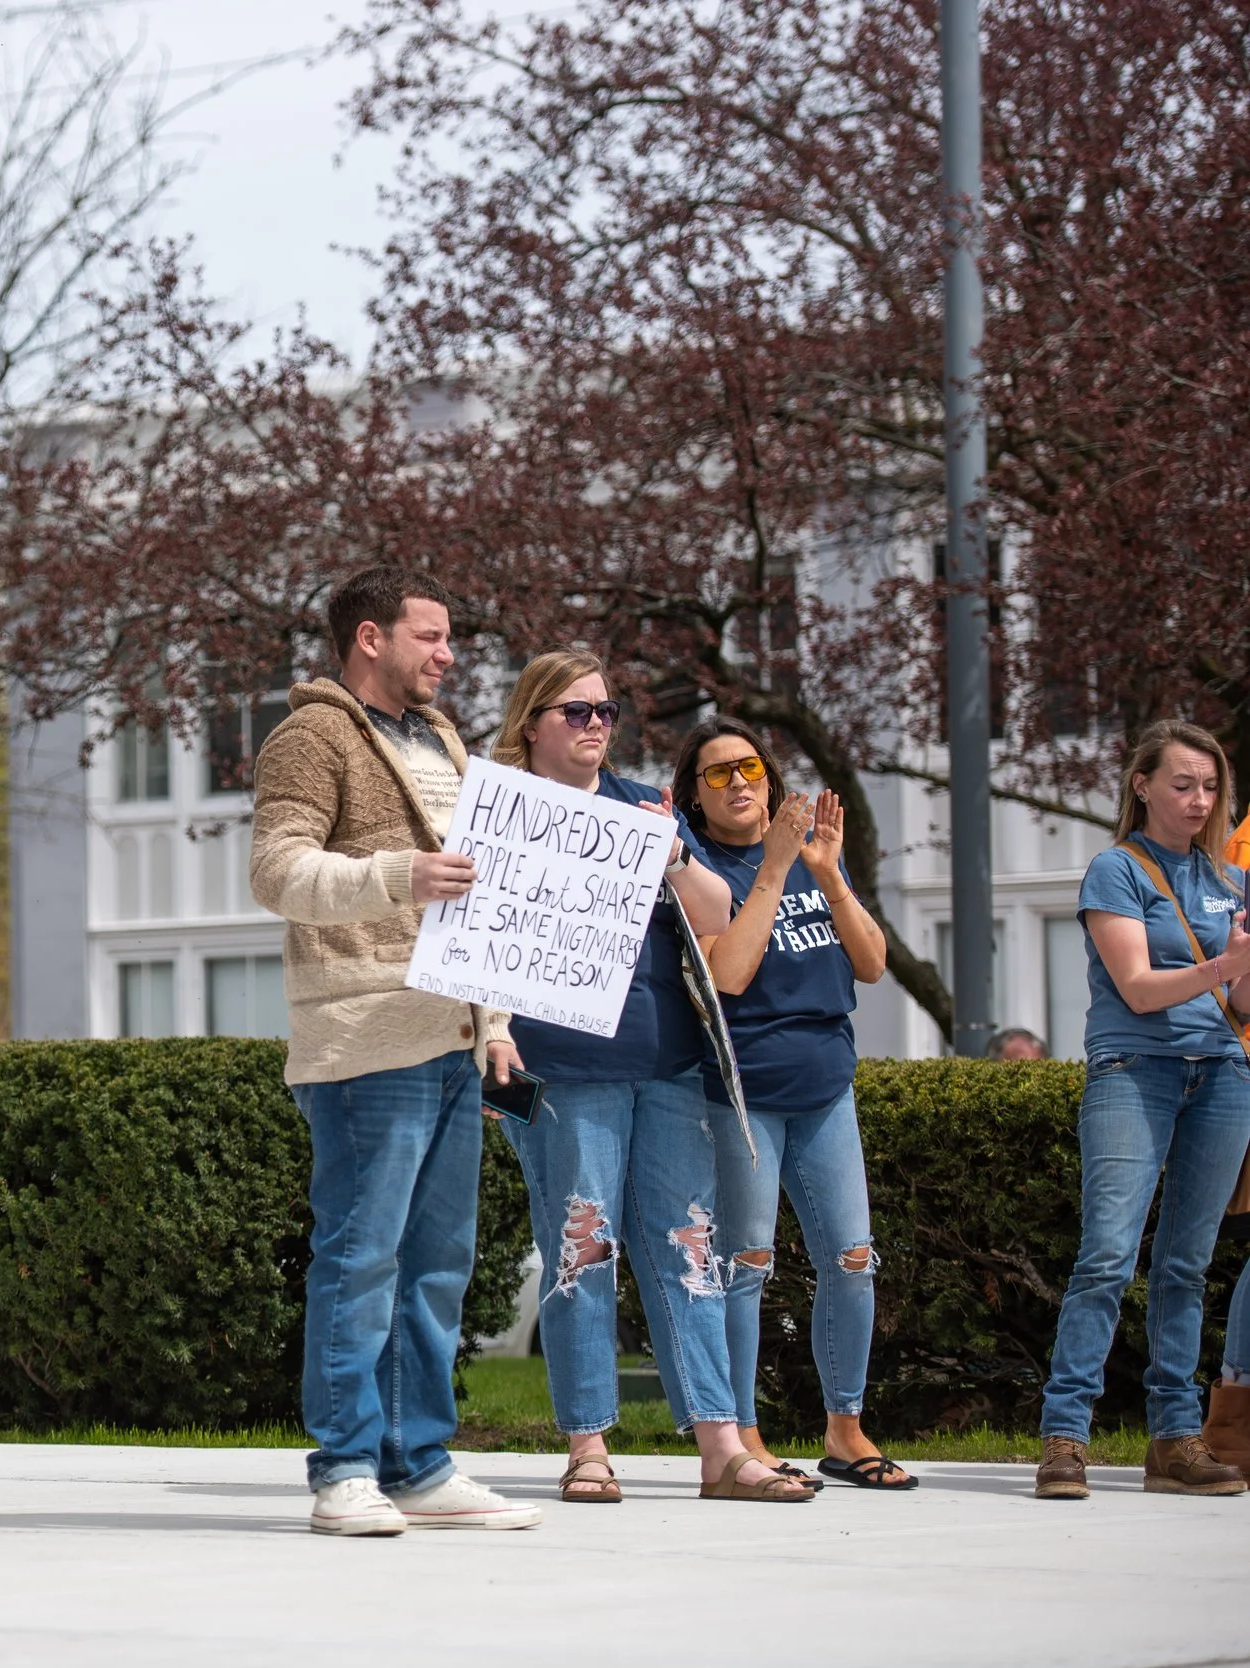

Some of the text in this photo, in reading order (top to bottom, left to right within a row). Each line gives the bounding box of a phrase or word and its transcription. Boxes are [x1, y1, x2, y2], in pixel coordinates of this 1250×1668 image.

[469, 778, 662, 875] HUNDREDS OF
[458, 837, 527, 896] PEOPLE
[576, 874, 653, 926] SHARE
[488, 903, 553, 938] SAME
[551, 918, 643, 970] NIGTMARES
[783, 919, 796, 930] AT
[784, 920, 841, 952] RIDG
[484, 940, 522, 974] NO
[526, 947, 614, 992] REASON
[418, 972, 444, 994] END
[534, 1001, 566, 1024] CHILD
